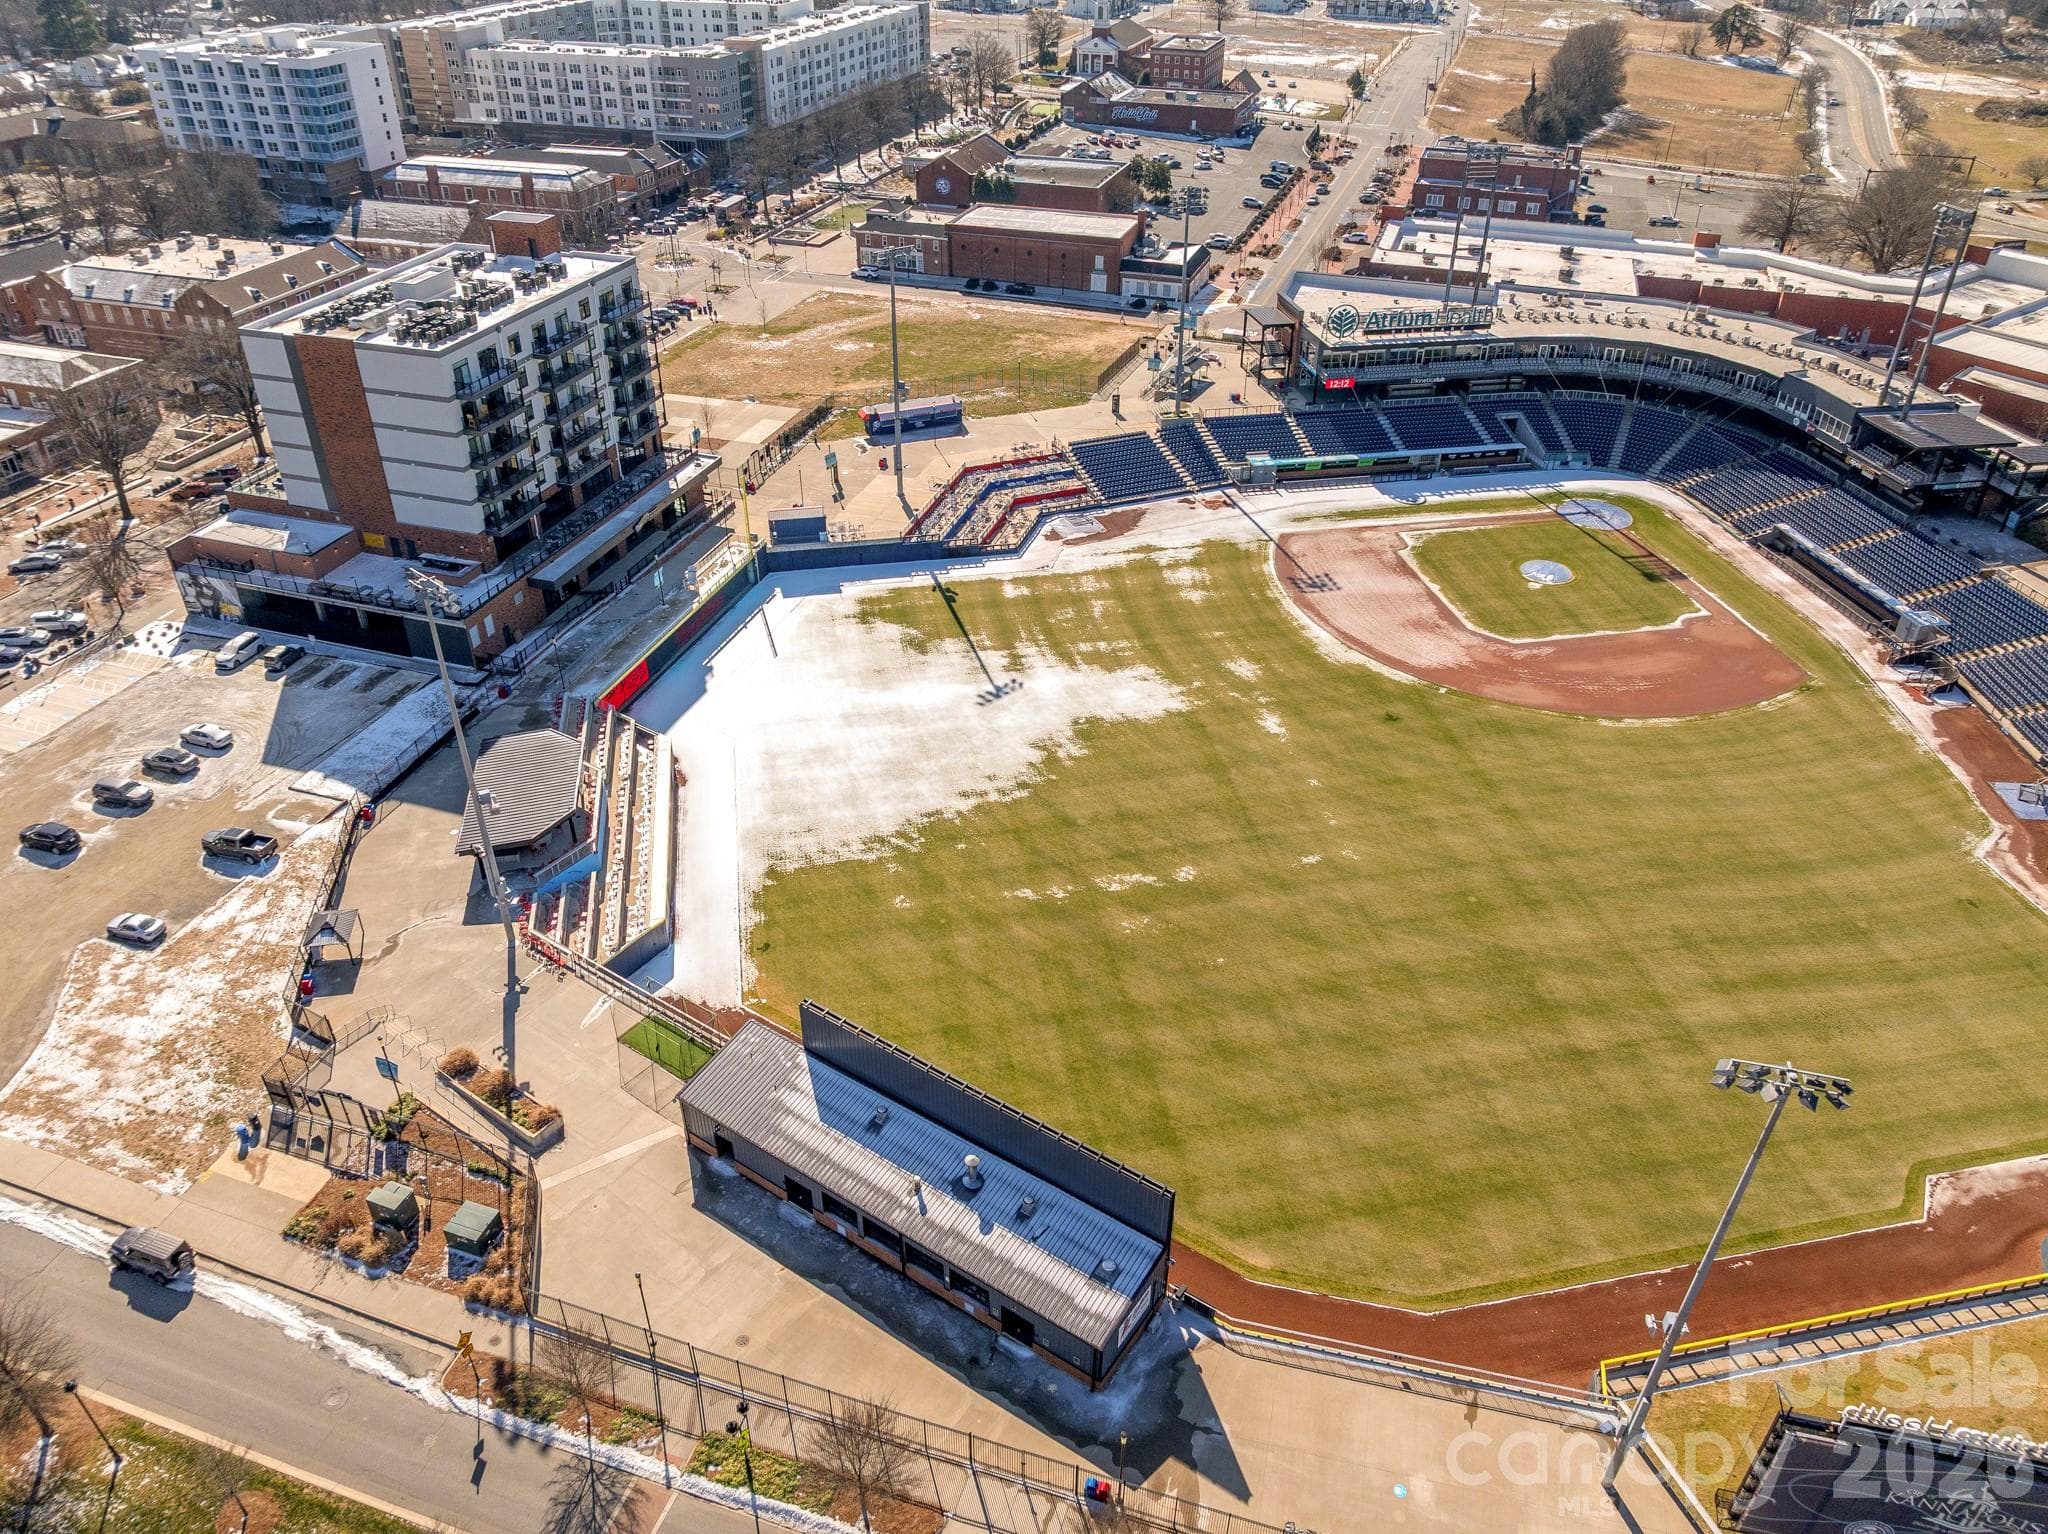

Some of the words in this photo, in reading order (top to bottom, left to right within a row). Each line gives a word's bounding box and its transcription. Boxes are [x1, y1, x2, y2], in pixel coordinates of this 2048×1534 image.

[1365, 311, 1433, 329] Atrium
[1436, 305, 1494, 326] Health
[1329, 379, 1350, 388] 12:12
